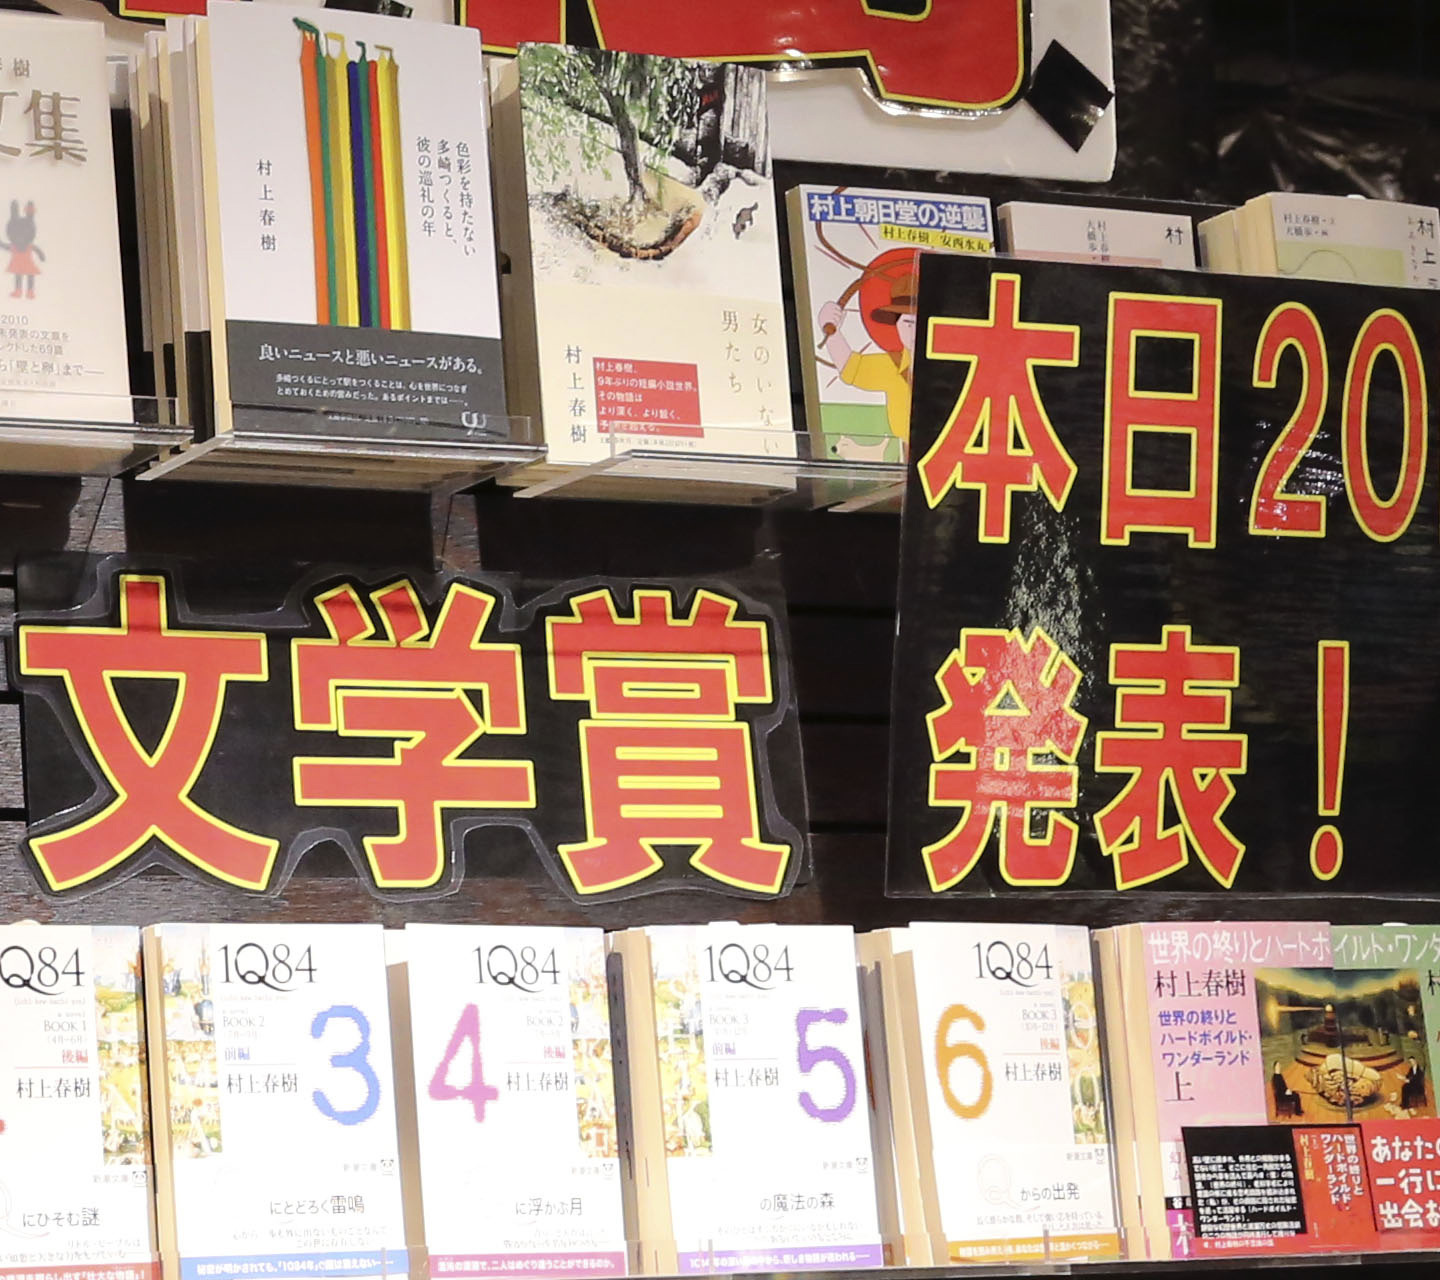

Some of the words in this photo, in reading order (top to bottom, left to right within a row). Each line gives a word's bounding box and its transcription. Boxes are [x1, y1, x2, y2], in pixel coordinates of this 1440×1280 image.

[416, 135, 437, 237] 彼の巡礼の年
[436, 138, 459, 246] 多崎つくると、
[455, 140, 477, 257] 色彩を持たない
[256, 158, 278, 252] 村上春樹
[810, 194, 988, 233] 村上朝日堂の逆襲
[258, 343, 484, 376] 良いニュースと悪いニュースがある。
[721, 308, 744, 395] 男たち
[18, 574, 792, 895] 文学賞
[218, 942, 318, 992] 1Q84
[471, 944, 561, 994] 1Q84
[703, 942, 795, 991] 1Q84
[972, 939, 1054, 988] 1Q84
[1154, 969, 1247, 999] 村上春樹
[1158, 1008, 1237, 1026] 世界の終りと
[543, 1045, 566, 1060] 後編
[1039, 1037, 1060, 1052] 後編
[1160, 1028, 1253, 1047] ハードボイルド・
[61, 1049, 89, 1064] 後編
[224, 1046, 251, 1061] 前編
[310, 1004, 381, 1126] 3
[428, 1003, 499, 1123] 4
[794, 1006, 858, 1123] 5
[934, 1003, 994, 1121] 6
[1161, 1049, 1251, 1069] ワンダーランド
[226, 1072, 298, 1095] 村上春樹
[506, 1070, 569, 1093] 村上春樹
[713, 1067, 780, 1089] 村上春樹
[1003, 1061, 1063, 1083] 村上春樹
[269, 1195, 366, 1217] にとどろく雷鳴
[514, 1196, 584, 1217] に浮かぶ月
[759, 1192, 836, 1212] の魔法の森
[1020, 1182, 1081, 1203] からの出発
[21, 1207, 101, 1230] にひそむ謎
